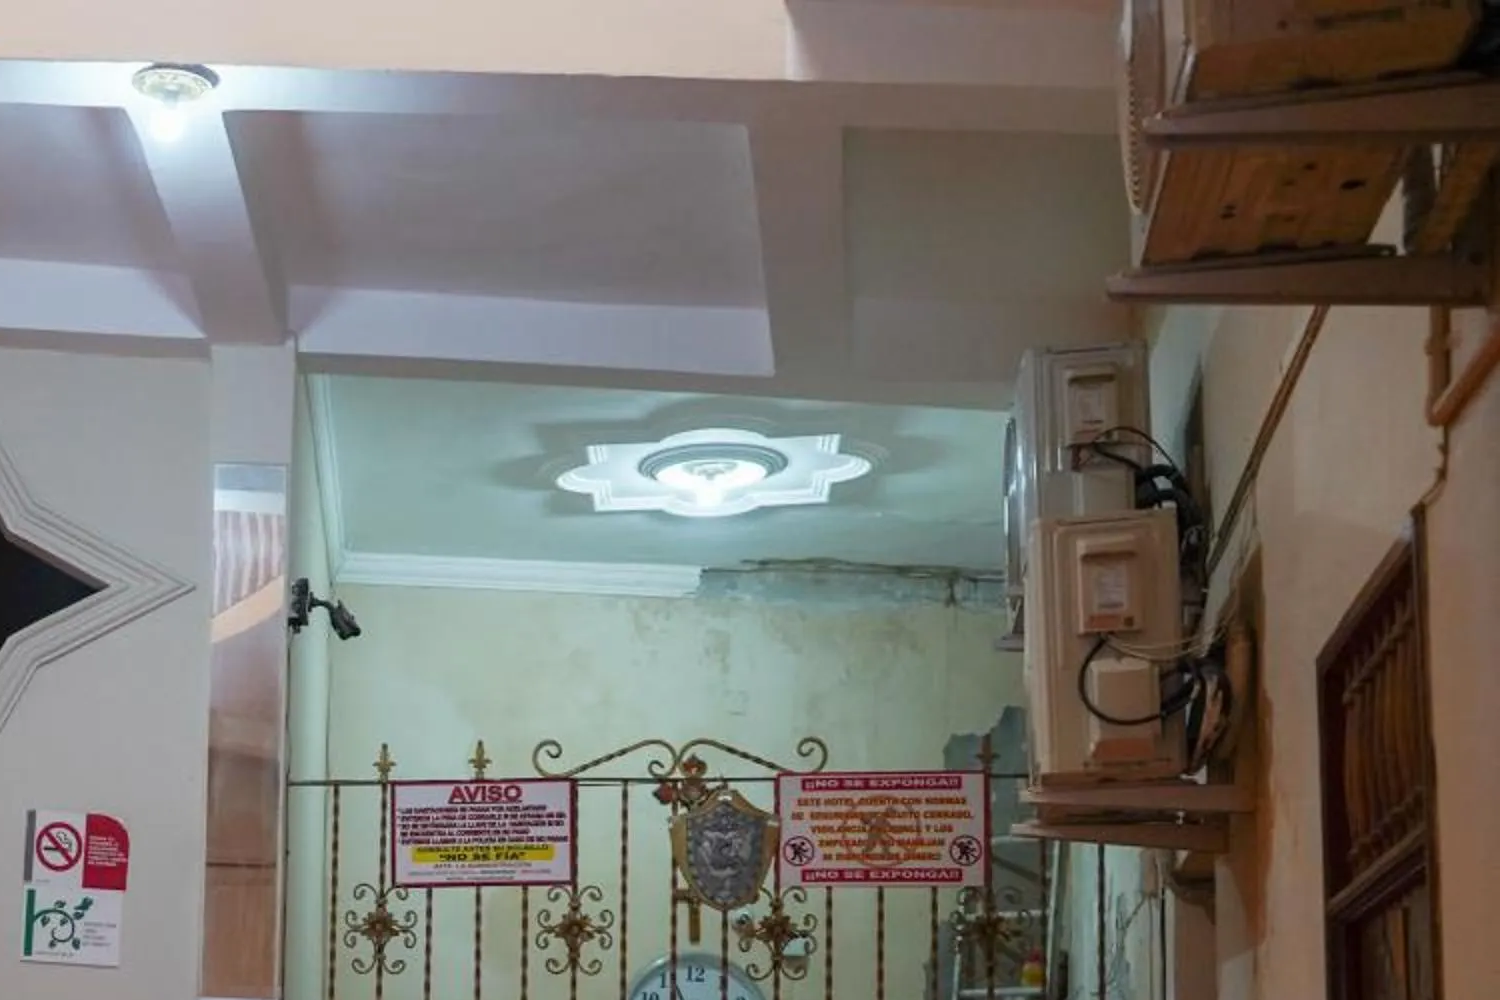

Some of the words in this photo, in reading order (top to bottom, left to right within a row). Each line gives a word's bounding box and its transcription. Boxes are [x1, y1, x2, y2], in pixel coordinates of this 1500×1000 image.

[843, 779, 864, 788] SE
[448, 785, 522, 802] AVISO
[472, 853, 490, 861] SE
[843, 871, 865, 880] SE
[685, 965, 706, 983] 12
